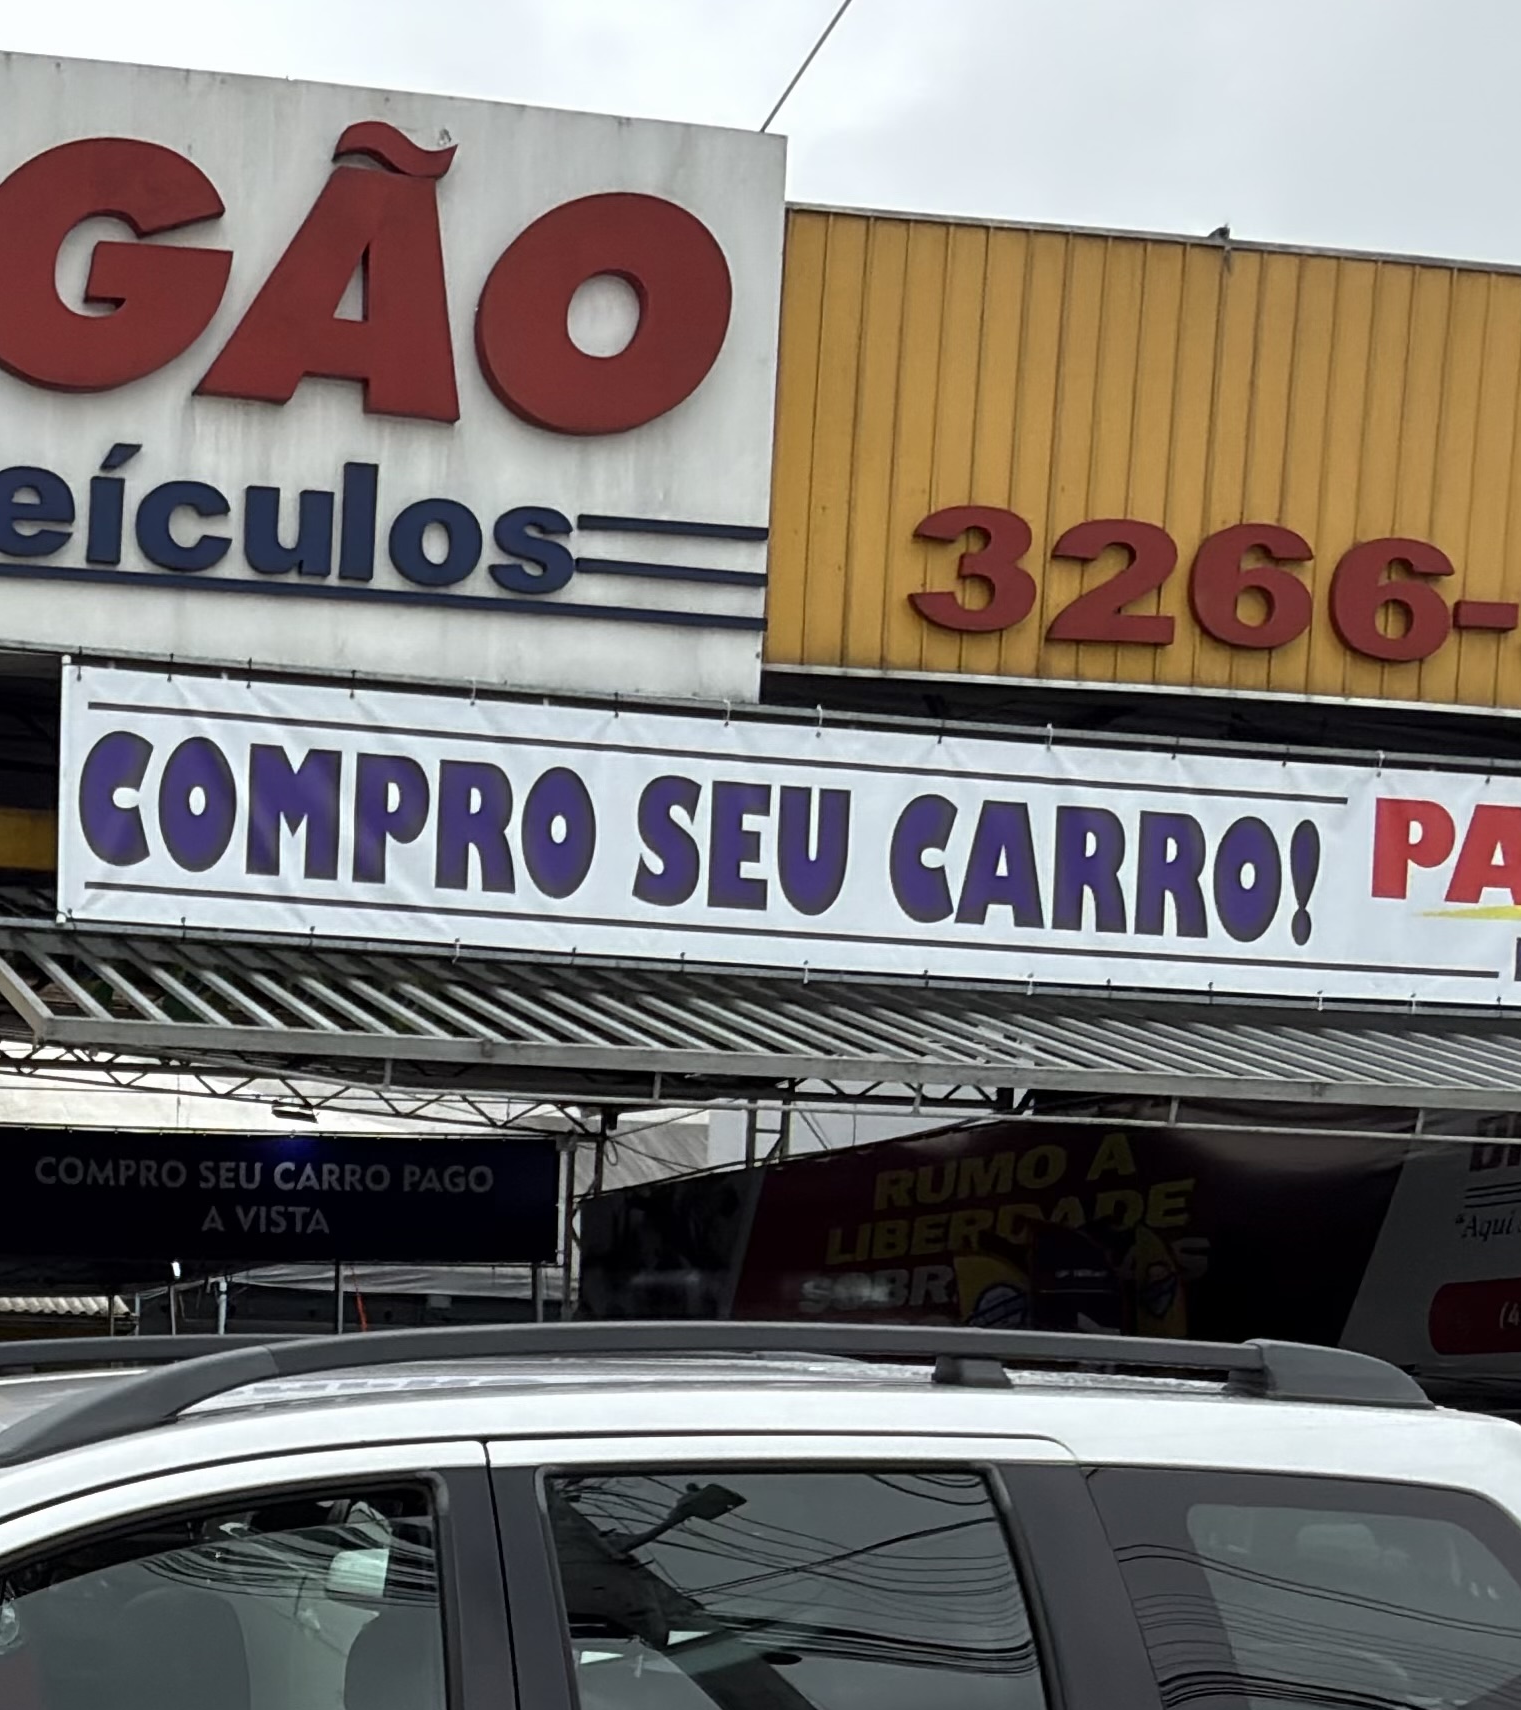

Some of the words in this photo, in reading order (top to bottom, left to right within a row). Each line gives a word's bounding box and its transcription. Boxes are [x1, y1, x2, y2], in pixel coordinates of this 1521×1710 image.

[78, 730, 597, 901] COMPRO
[632, 774, 852, 917] SEU
[890, 793, 1321, 946] CARRO!
[35, 1155, 187, 1189] COMPRO
[199, 1160, 261, 1190] SEU
[273, 1161, 392, 1193] CARRO
[403, 1165, 495, 1194] PAGO
[873, 1142, 1070, 1212] RUMO
[202, 1205, 225, 1233] A
[235, 1205, 330, 1235] VISTA
[798, 1263, 957, 1314] SOBR
